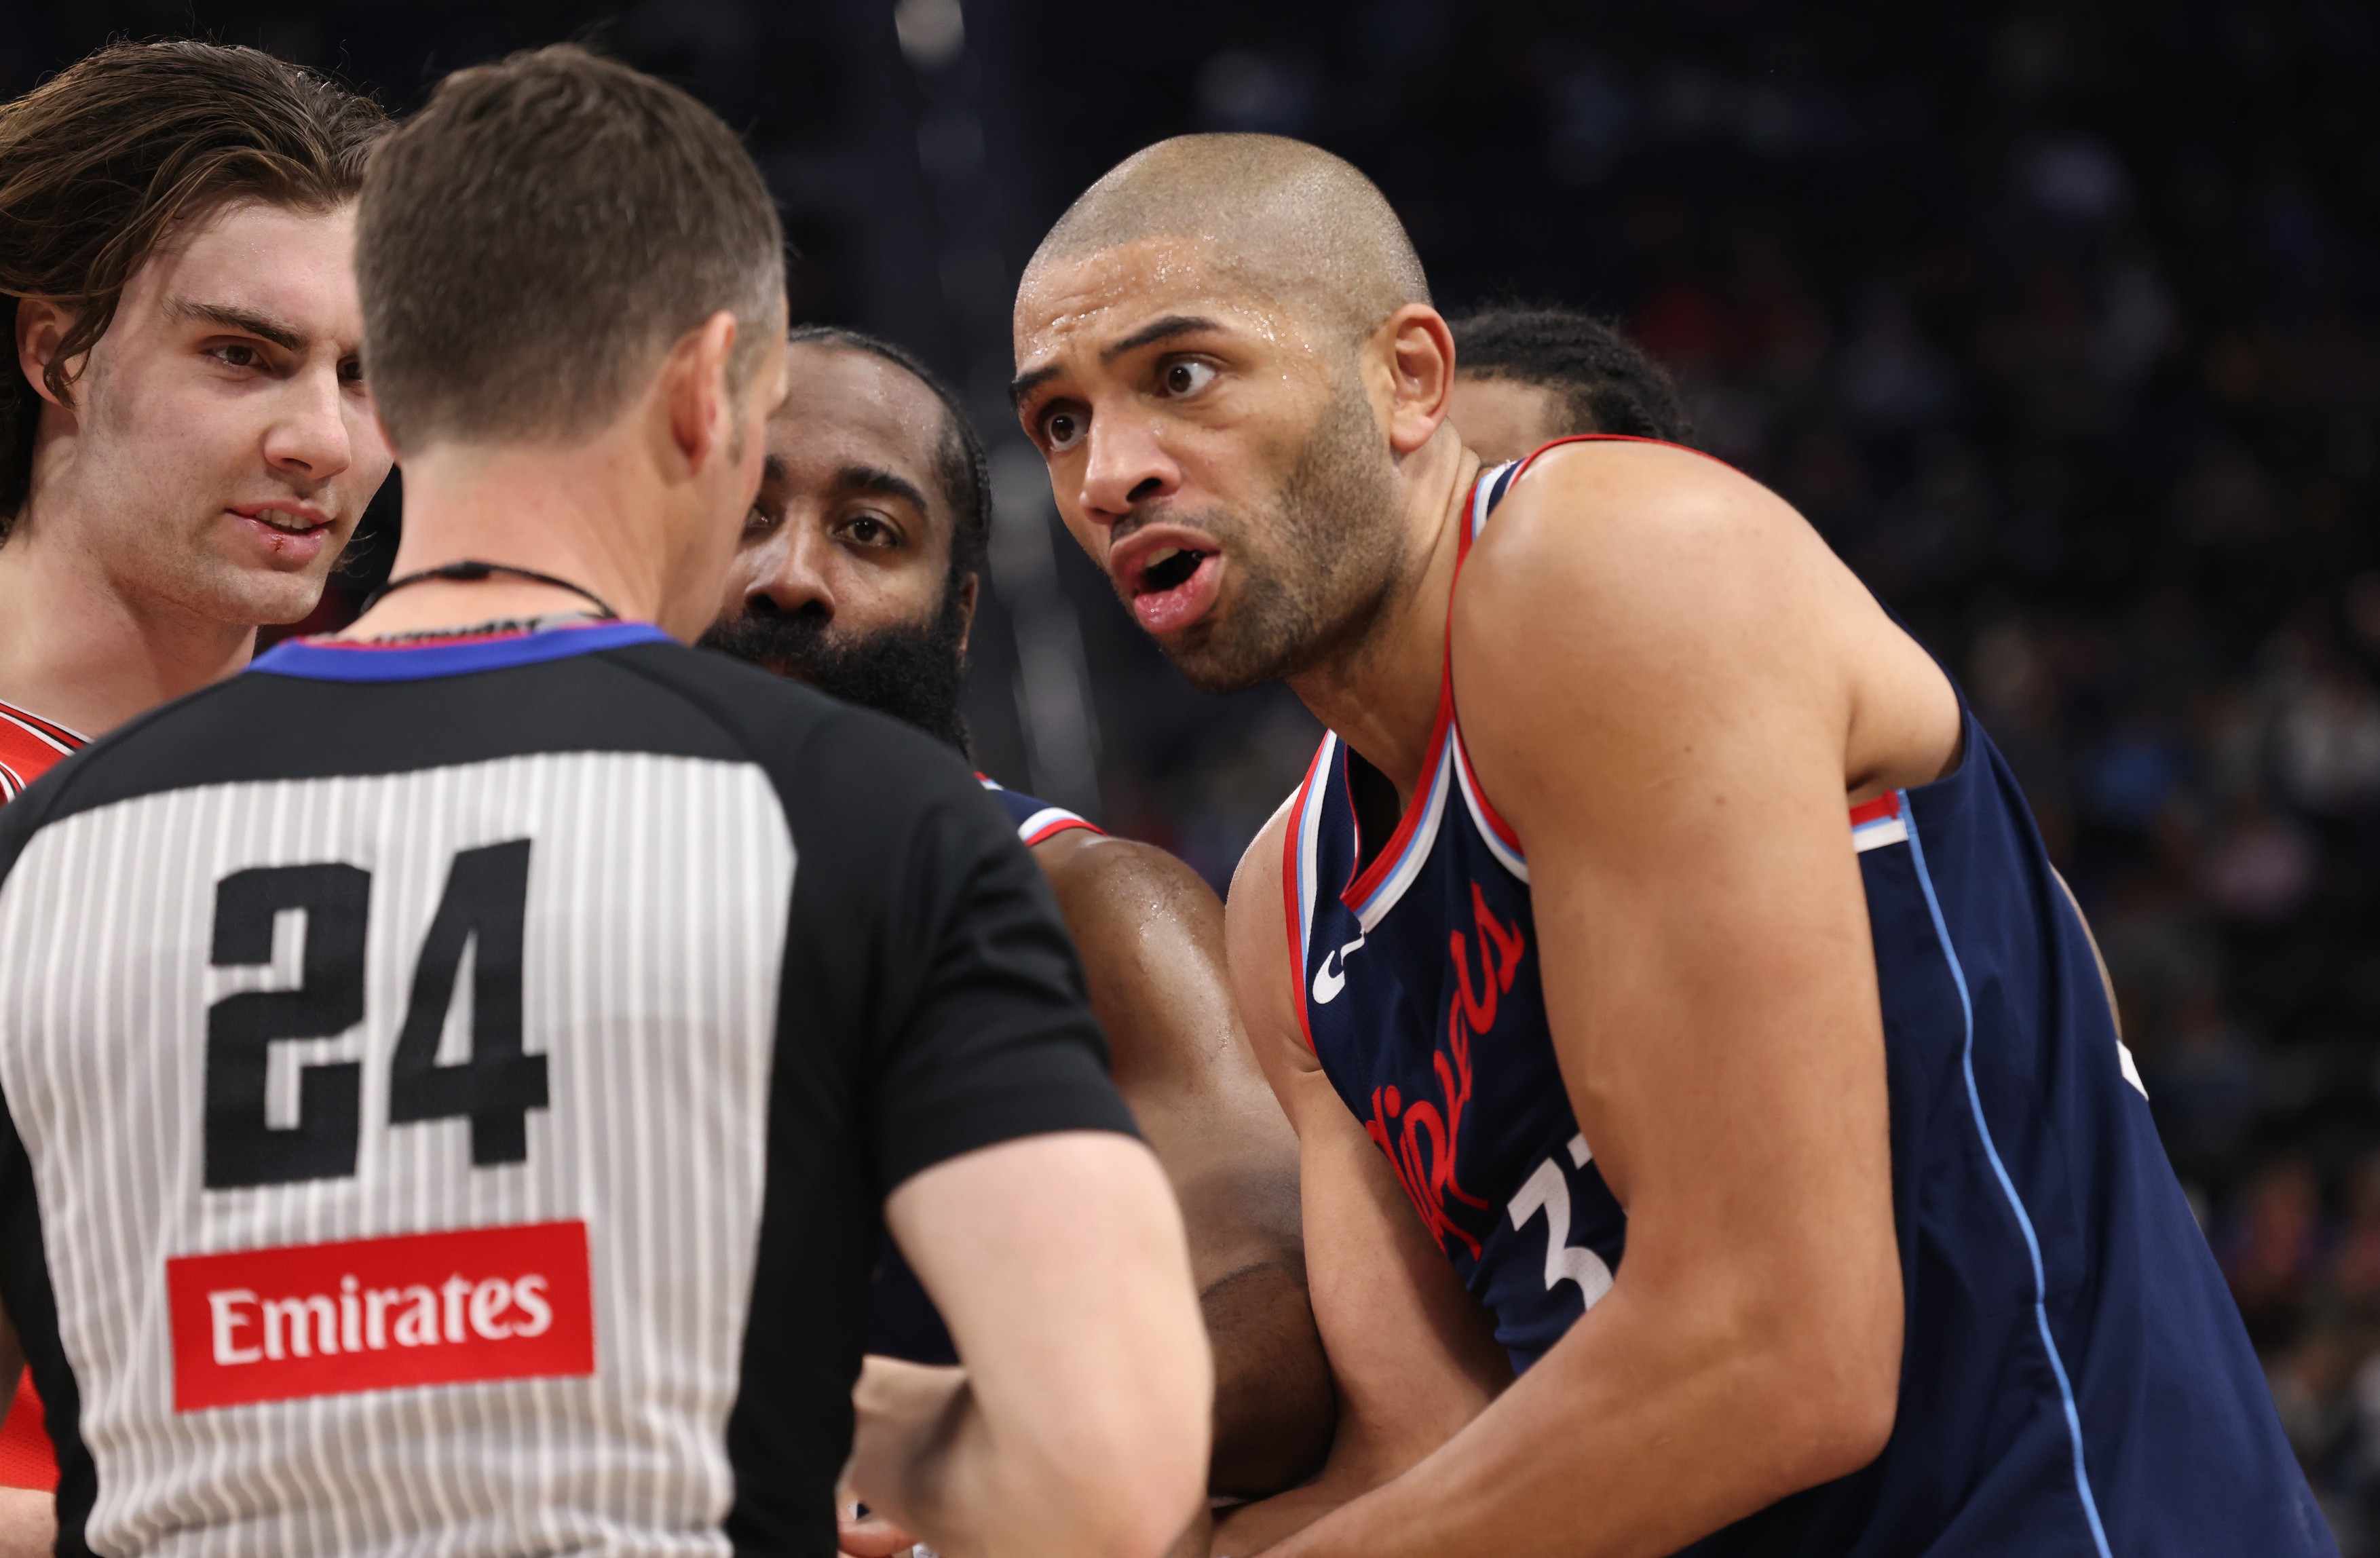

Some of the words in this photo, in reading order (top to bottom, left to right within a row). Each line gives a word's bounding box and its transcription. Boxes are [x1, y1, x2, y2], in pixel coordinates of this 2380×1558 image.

[202, 838, 550, 1192] 24
[1507, 1132, 1615, 1312] 3
[207, 1273, 552, 1366] Emirates
